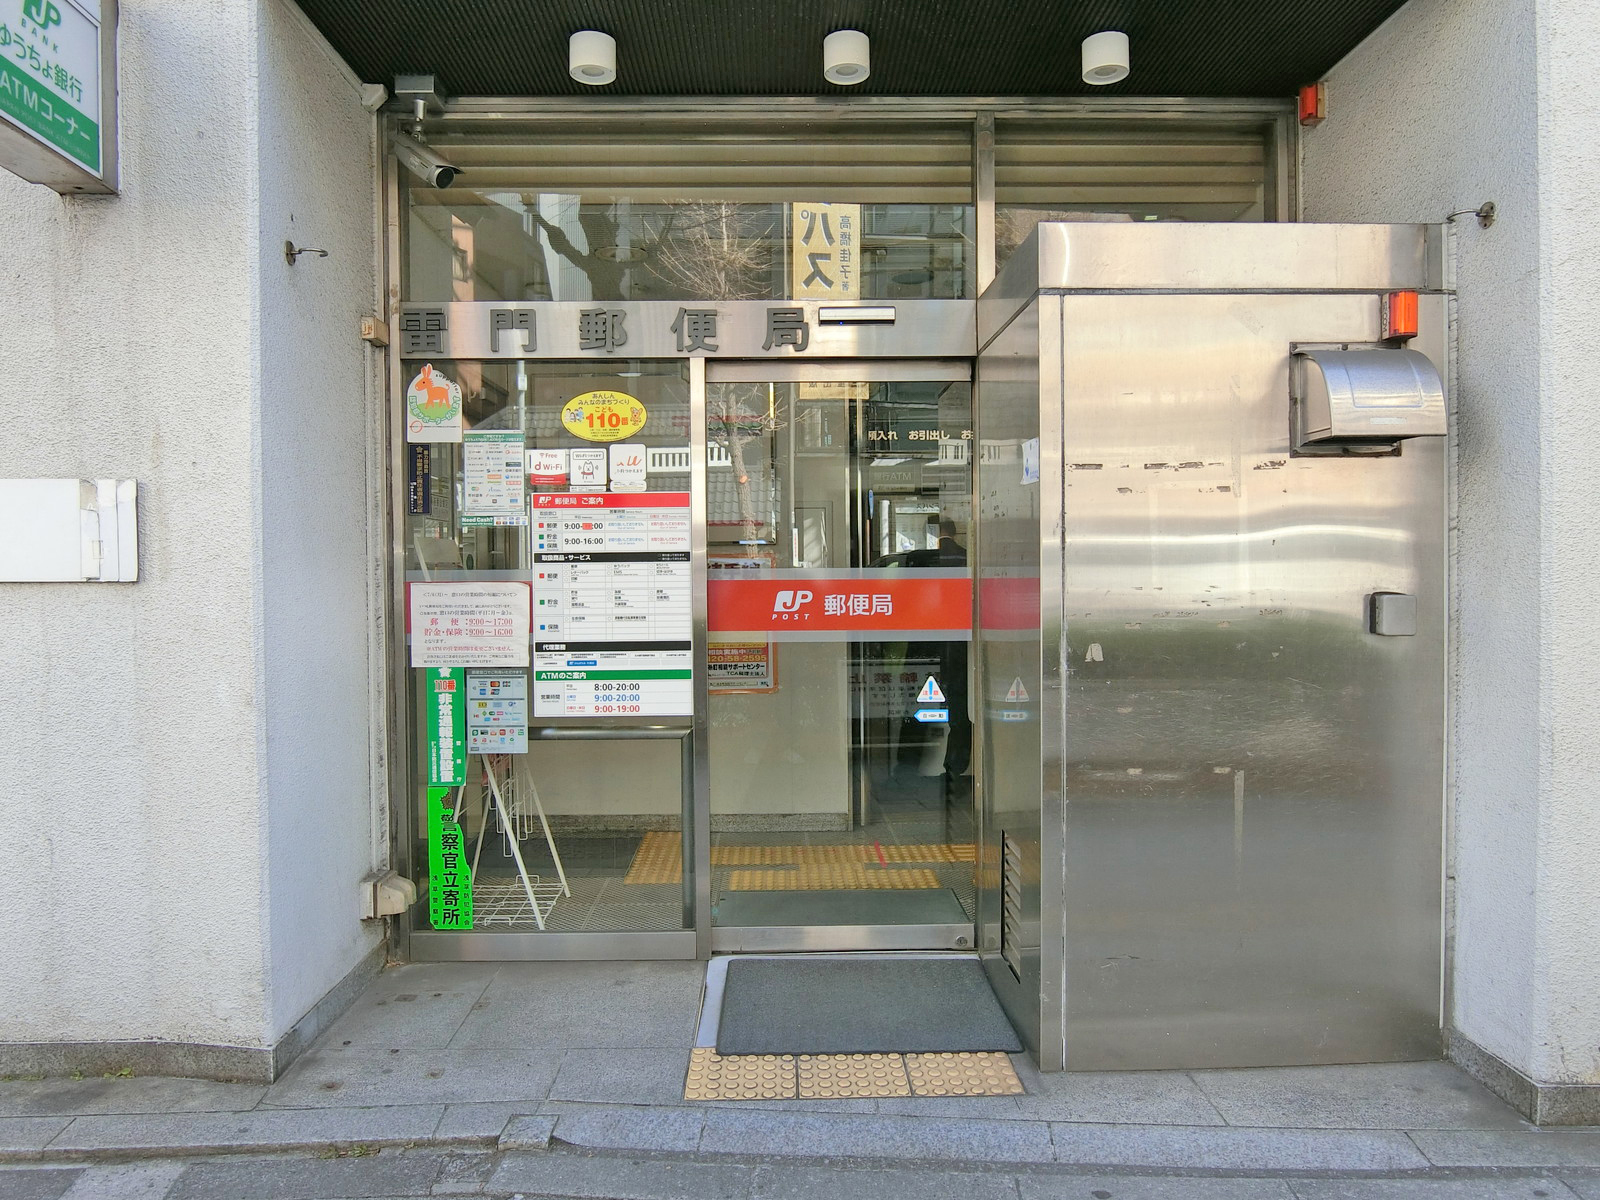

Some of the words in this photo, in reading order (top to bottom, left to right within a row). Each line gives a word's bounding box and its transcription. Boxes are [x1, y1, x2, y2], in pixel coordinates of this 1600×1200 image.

[21, 17, 59, 53] BANK
[0, 23, 82, 103] ゆうちょ銀行
[0, 69, 91, 141] ATMコーナー
[400, 307, 810, 353] 雷門郵便局
[586, 413, 629, 428] 110番
[908, 430, 951, 440] お引出し
[961, 430, 974, 440] お
[543, 462, 563, 471] Wi-Fi
[554, 496, 577, 505] 郵便局
[581, 496, 604, 505] ご案内
[564, 522, 604, 530] 9:00-:00
[564, 537, 604, 546] 9:00-16:00
[773, 590, 814, 613] JP
[823, 593, 893, 616] 郵便局
[424, 628, 462, 637] 貯金・保険
[540, 672, 587, 680] ATMのご案内
[434, 680, 456, 691] 110番
[594, 683, 640, 691] 8:00-20:00
[594, 693, 640, 702] 9:00-20:00
[594, 704, 640, 713] 9:00-19:00
[440, 814, 460, 926] 警察官立寄所
